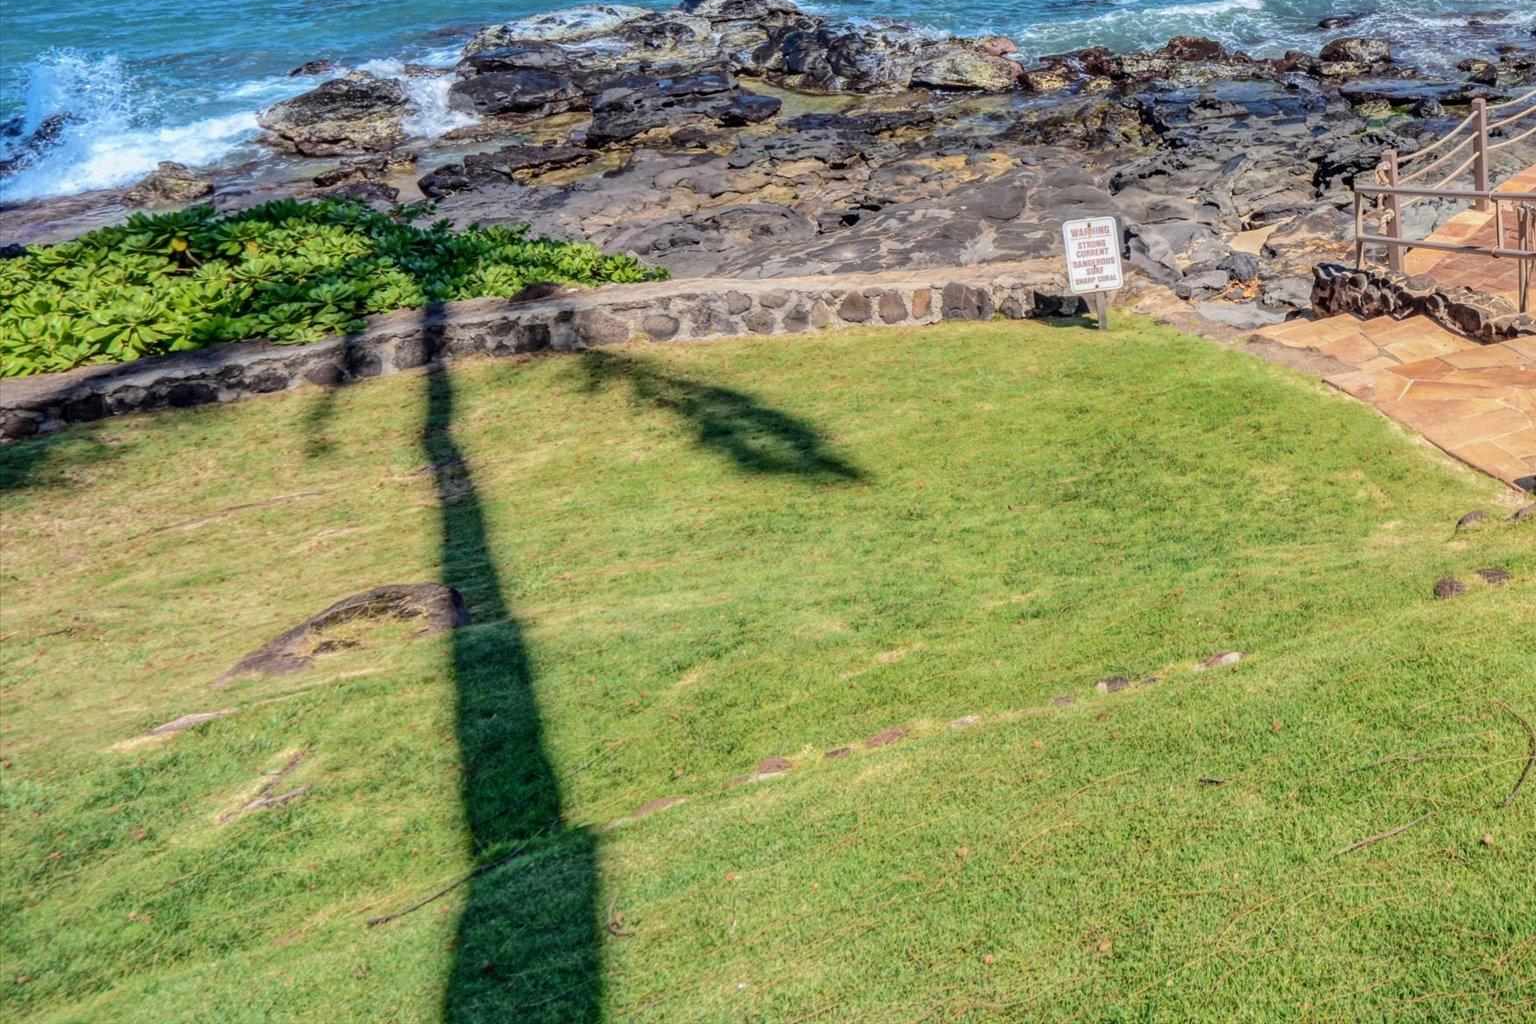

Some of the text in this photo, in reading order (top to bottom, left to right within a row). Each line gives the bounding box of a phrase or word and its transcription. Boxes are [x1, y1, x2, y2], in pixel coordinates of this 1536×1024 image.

[1071, 225, 1110, 237] WARNING
[1076, 248, 1109, 258] CURRENT
[1072, 257, 1115, 268] DANGEROUS
